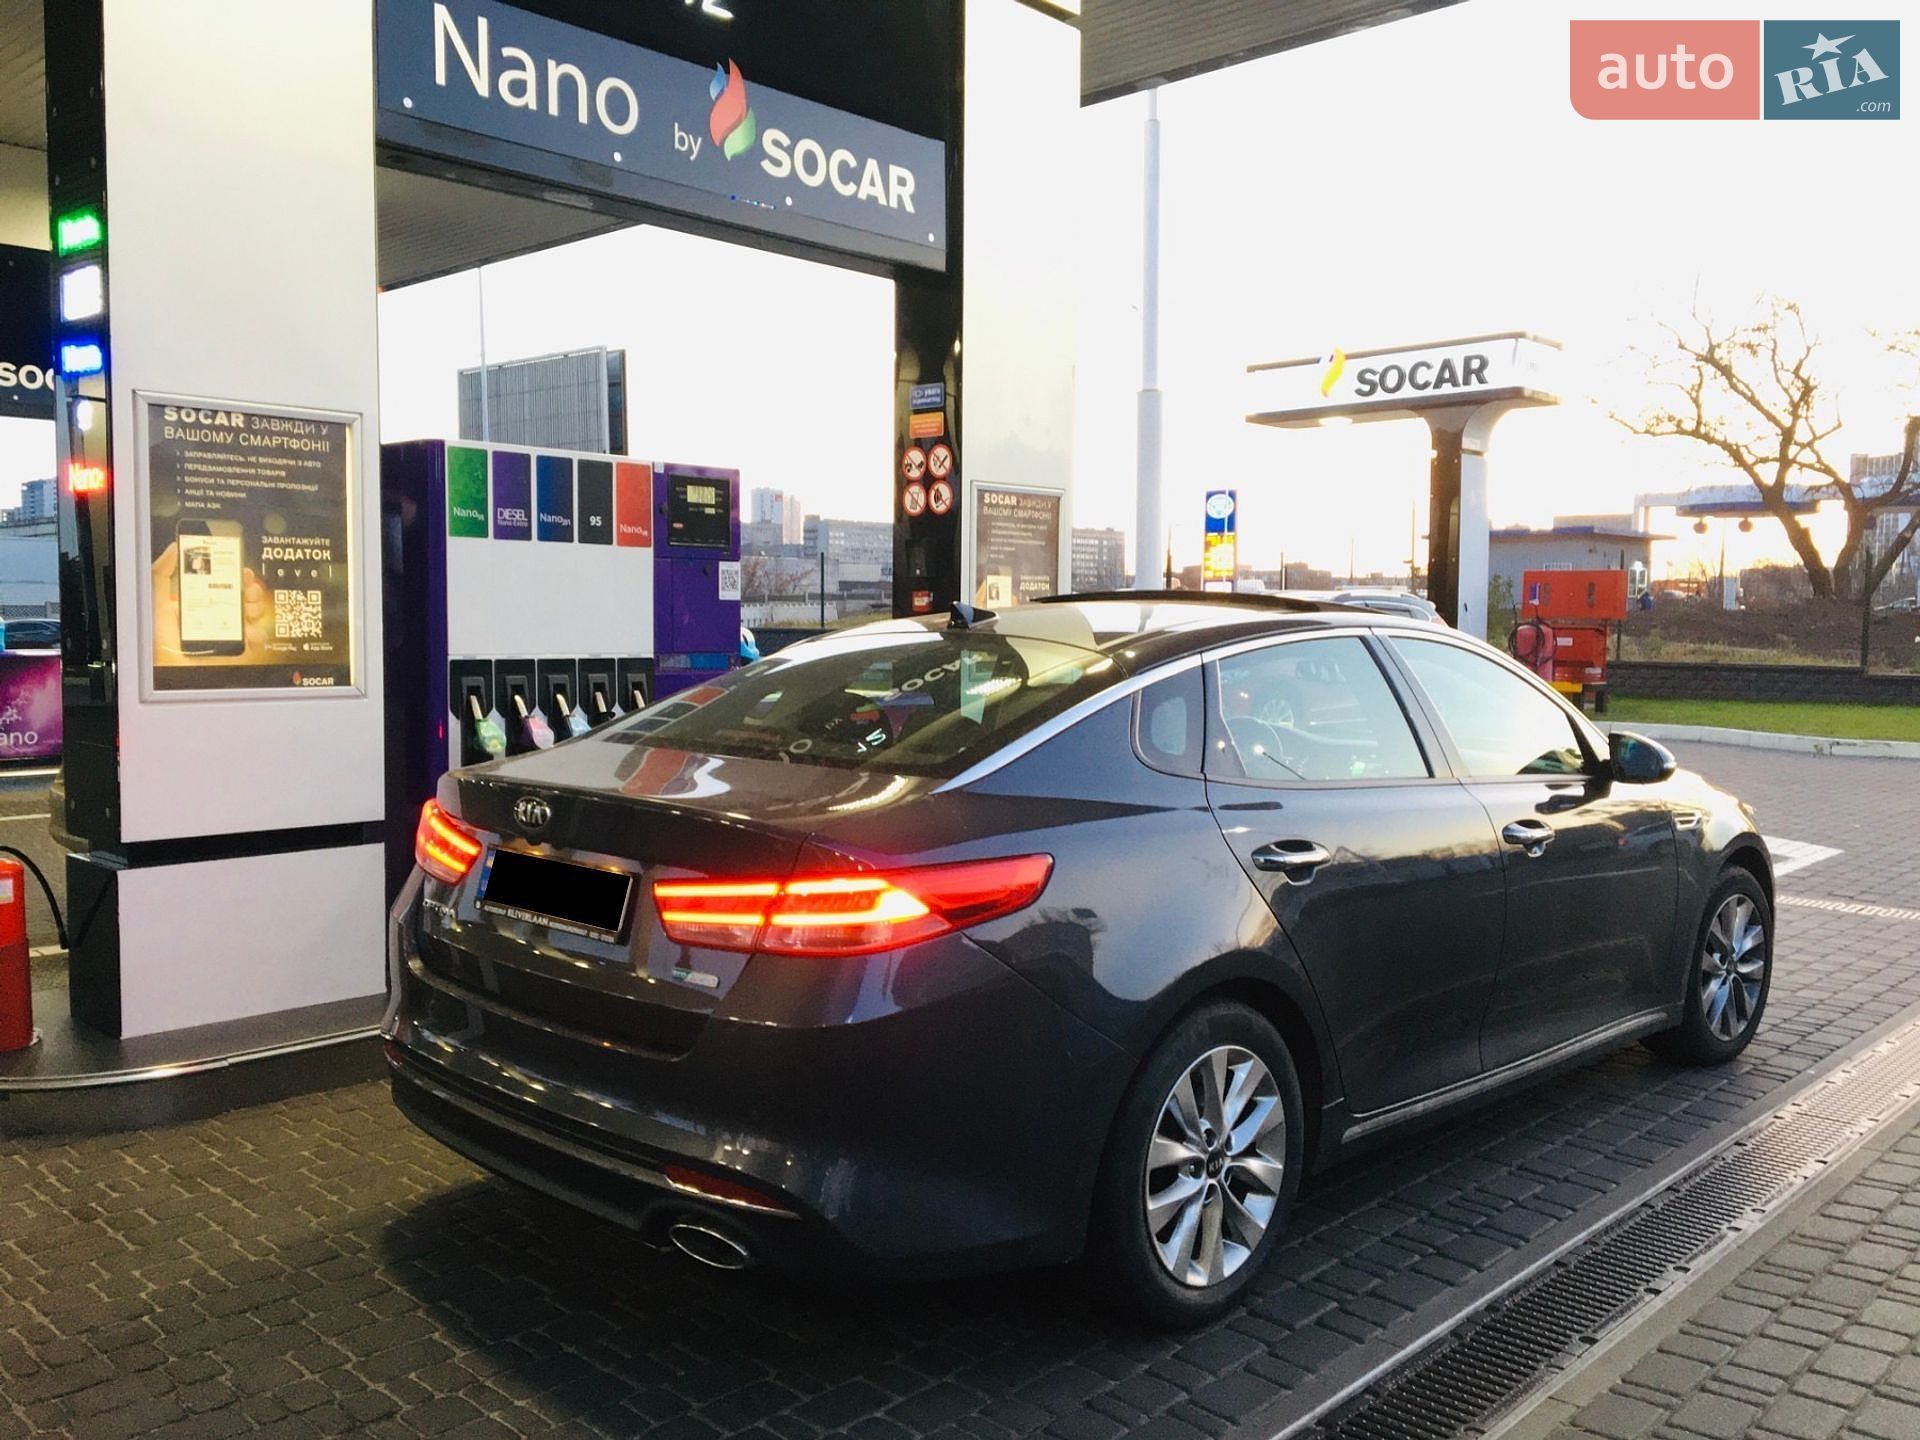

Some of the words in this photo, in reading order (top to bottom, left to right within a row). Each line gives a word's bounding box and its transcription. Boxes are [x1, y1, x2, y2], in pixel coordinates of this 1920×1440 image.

[433, 2, 639, 136] Nano
[673, 122, 702, 161] by
[760, 127, 916, 213] SOCAR
[1354, 354, 1490, 397] SOCAR
[163, 406, 245, 428] SOCAR
[251, 416, 315, 436] ЗАВЖДИ
[320, 422, 329, 436] У
[163, 426, 234, 444] ВАШОМУ
[983, 492, 1017, 506] SOCAR
[497, 507, 528, 521] DIESEL
[589, 515, 602, 527] 95
[261, 535, 331, 548] ЗАВАНТАЖУЙТЕ
[261, 547, 331, 561] ДОДАТОК
[302, 677, 334, 687] SOCAR
[0, 731, 38, 745] ano
[514, 798, 548, 827] KIA
